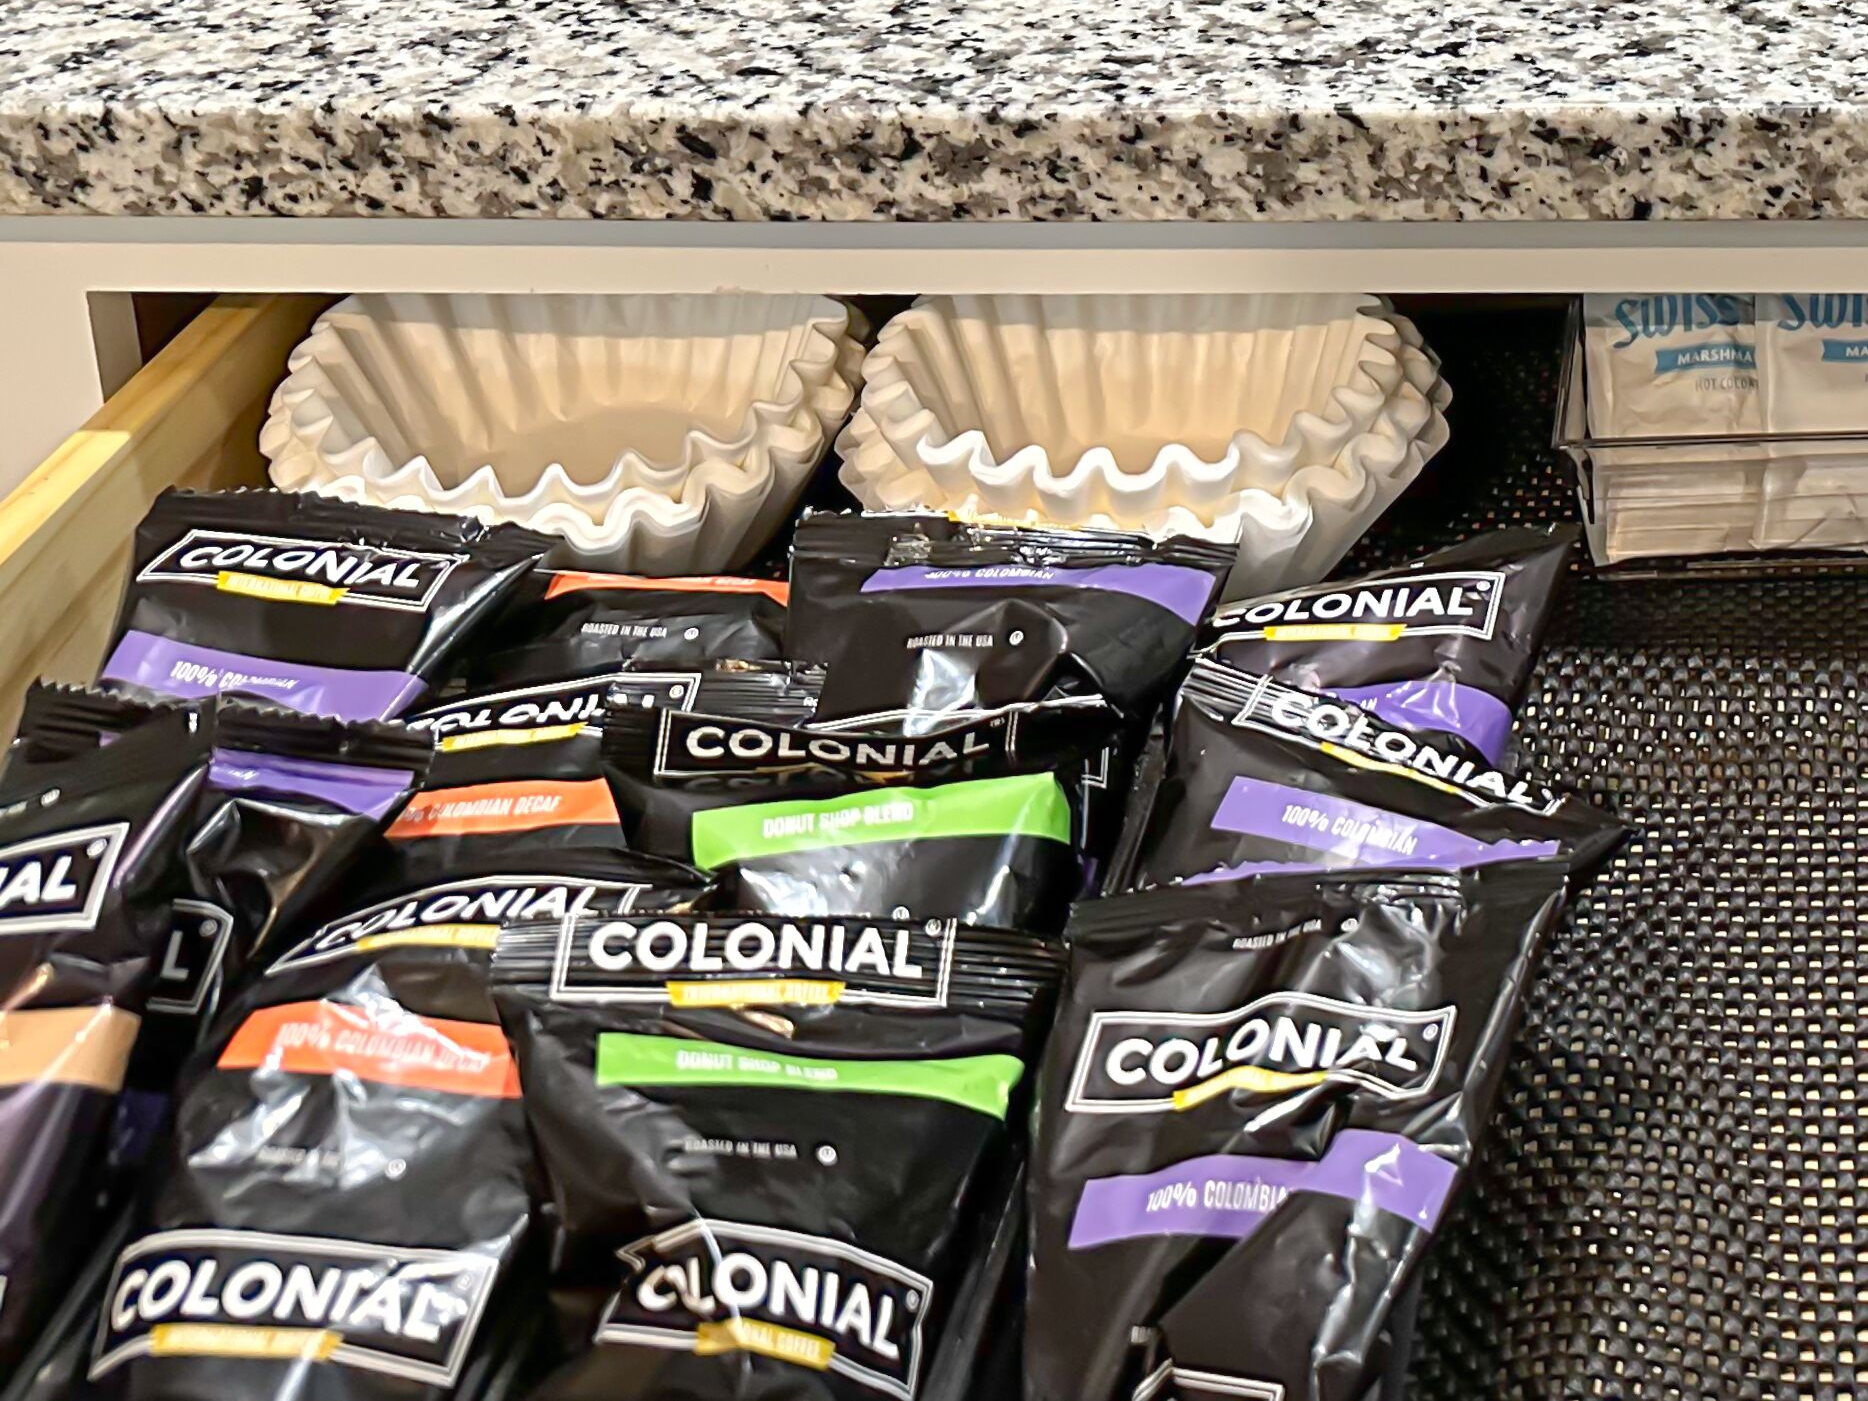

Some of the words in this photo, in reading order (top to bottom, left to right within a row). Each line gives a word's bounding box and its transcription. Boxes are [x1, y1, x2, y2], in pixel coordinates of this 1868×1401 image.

[1677, 349, 1753, 366] MARSHMA
[179, 544, 423, 587] COLONIAL
[1212, 585, 1475, 627] COLONIAL
[620, 624, 631, 636] IN
[632, 625, 648, 637] THE
[650, 627, 667, 638] USA
[945, 634, 956, 647] IN
[958, 633, 973, 648] THE
[976, 634, 993, 647] USA
[170, 660, 218, 687] 100%
[686, 725, 990, 766] COLONIAL
[1271, 691, 1533, 805] COLONIAL
[516, 794, 562, 815] DECAF
[763, 812, 814, 839] DONUT
[1281, 804, 1330, 832] 100%
[1331, 816, 1419, 856] COLOMBIAN
[315, 885, 598, 951] COLONIAL
[589, 920, 923, 978] COLONIAL
[676, 1049, 734, 1072] DONUT
[1106, 1017, 1417, 1086] COLONIAL
[752, 1141, 771, 1157] THE
[774, 1142, 797, 1158] USA
[1146, 1180, 1196, 1213] 100%
[111, 1259, 441, 1342] COLONIAL
